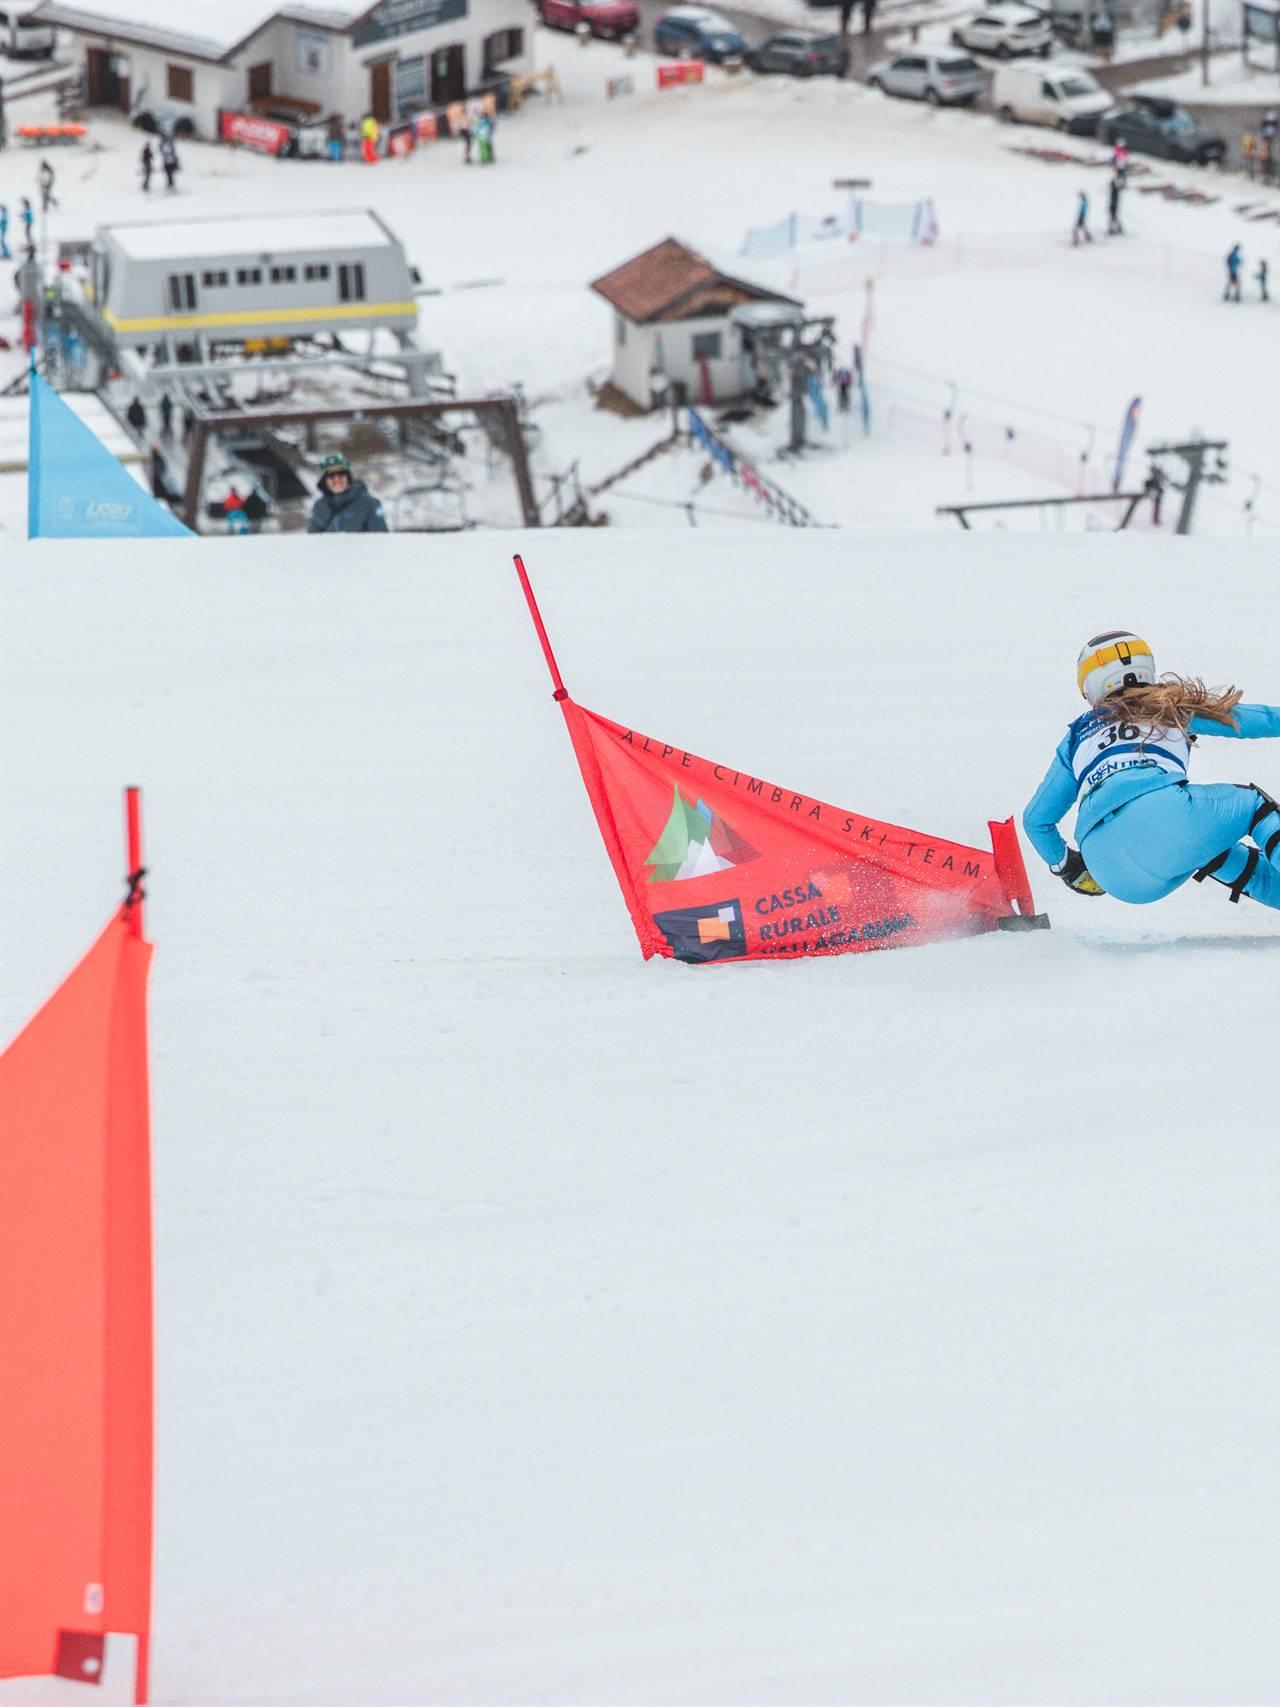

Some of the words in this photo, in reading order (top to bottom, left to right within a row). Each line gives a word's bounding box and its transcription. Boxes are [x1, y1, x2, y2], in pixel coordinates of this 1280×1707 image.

[1097, 722, 1141, 750] 36
[620, 730, 693, 768] ALPE
[713, 765, 822, 820] CIMBRA
[841, 818, 888, 846] SKI
[906, 844, 981, 879] TEAM
[754, 882, 823, 915] CASSA
[759, 905, 842, 941] RURALE
